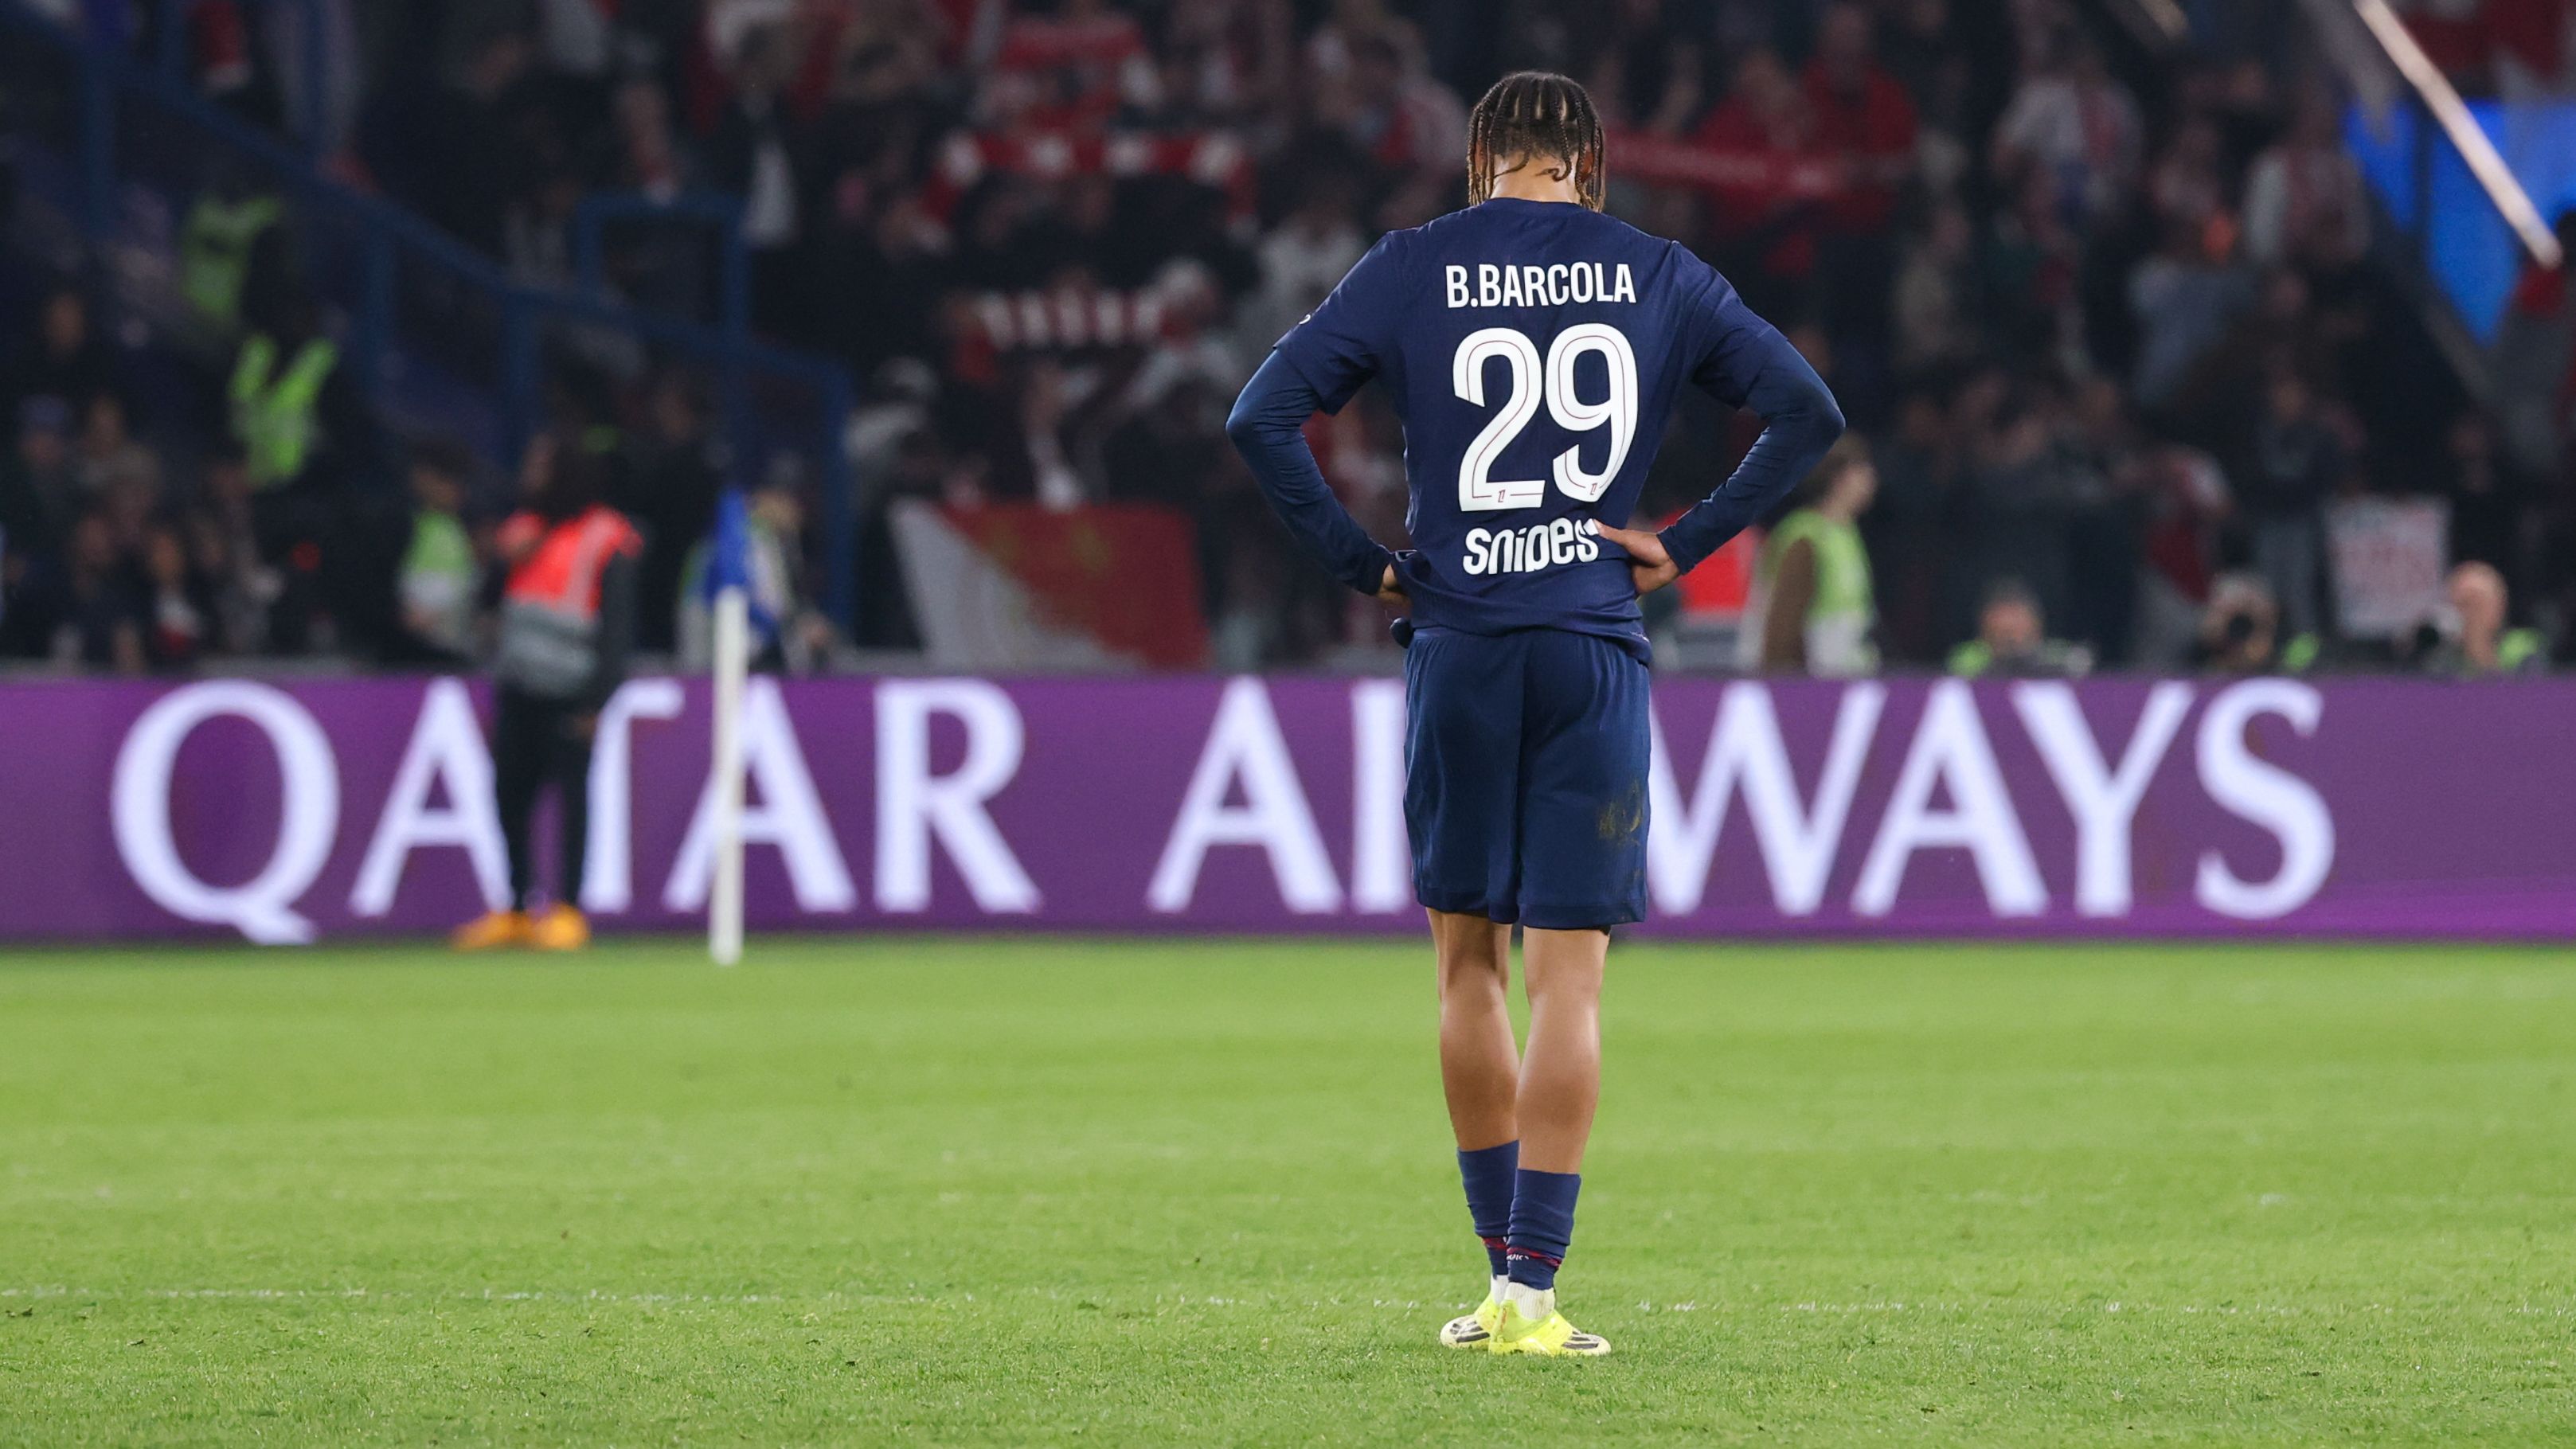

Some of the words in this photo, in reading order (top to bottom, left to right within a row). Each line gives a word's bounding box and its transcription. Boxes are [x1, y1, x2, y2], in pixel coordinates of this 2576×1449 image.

[1444, 261, 1637, 309] B.BARCOLA
[1452, 322, 1639, 512] 29
[111, 678, 1042, 946] QATAR
[1147, 675, 2335, 920] AIWAYS
